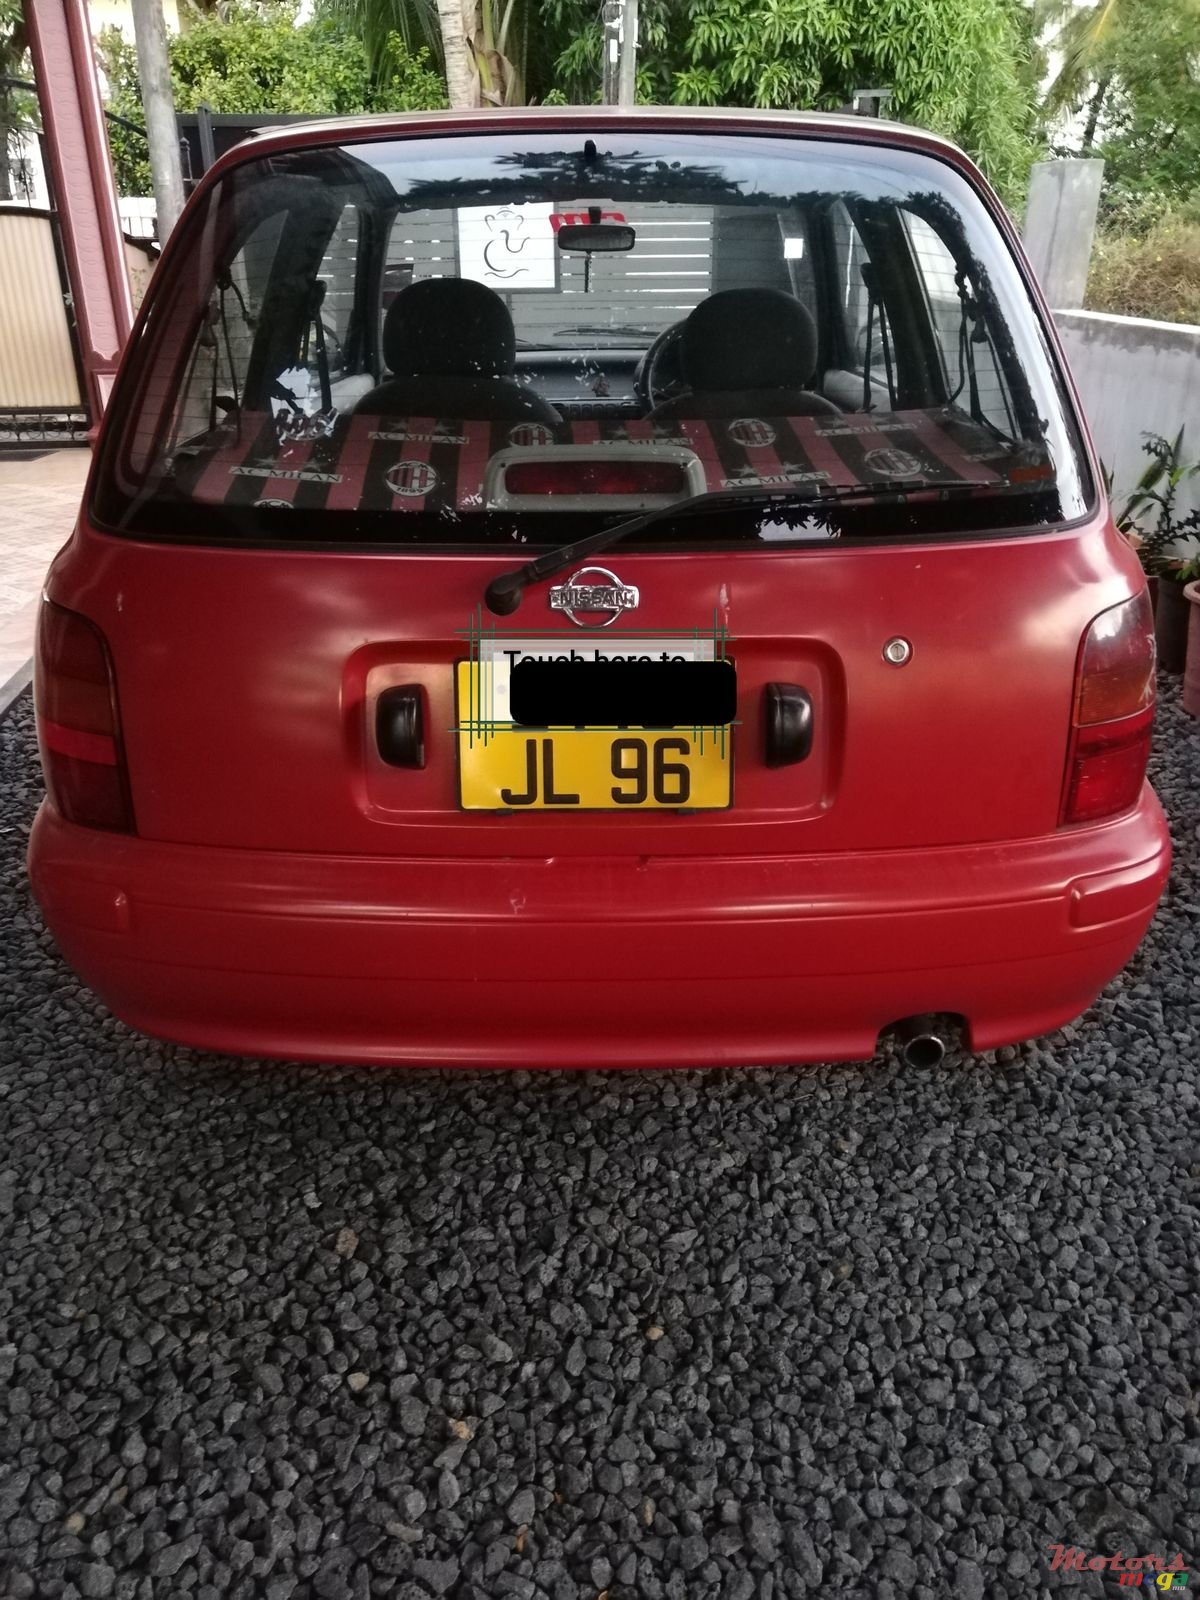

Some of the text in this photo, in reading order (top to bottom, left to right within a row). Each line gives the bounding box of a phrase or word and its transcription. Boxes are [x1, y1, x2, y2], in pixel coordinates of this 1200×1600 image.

[370, 432, 468, 445] AC MILAN
[231, 467, 340, 483] AC MILAN
[724, 473, 829, 488] AC MILAN
[560, 588, 635, 606] NISSAN
[501, 737, 691, 806] JL 96
